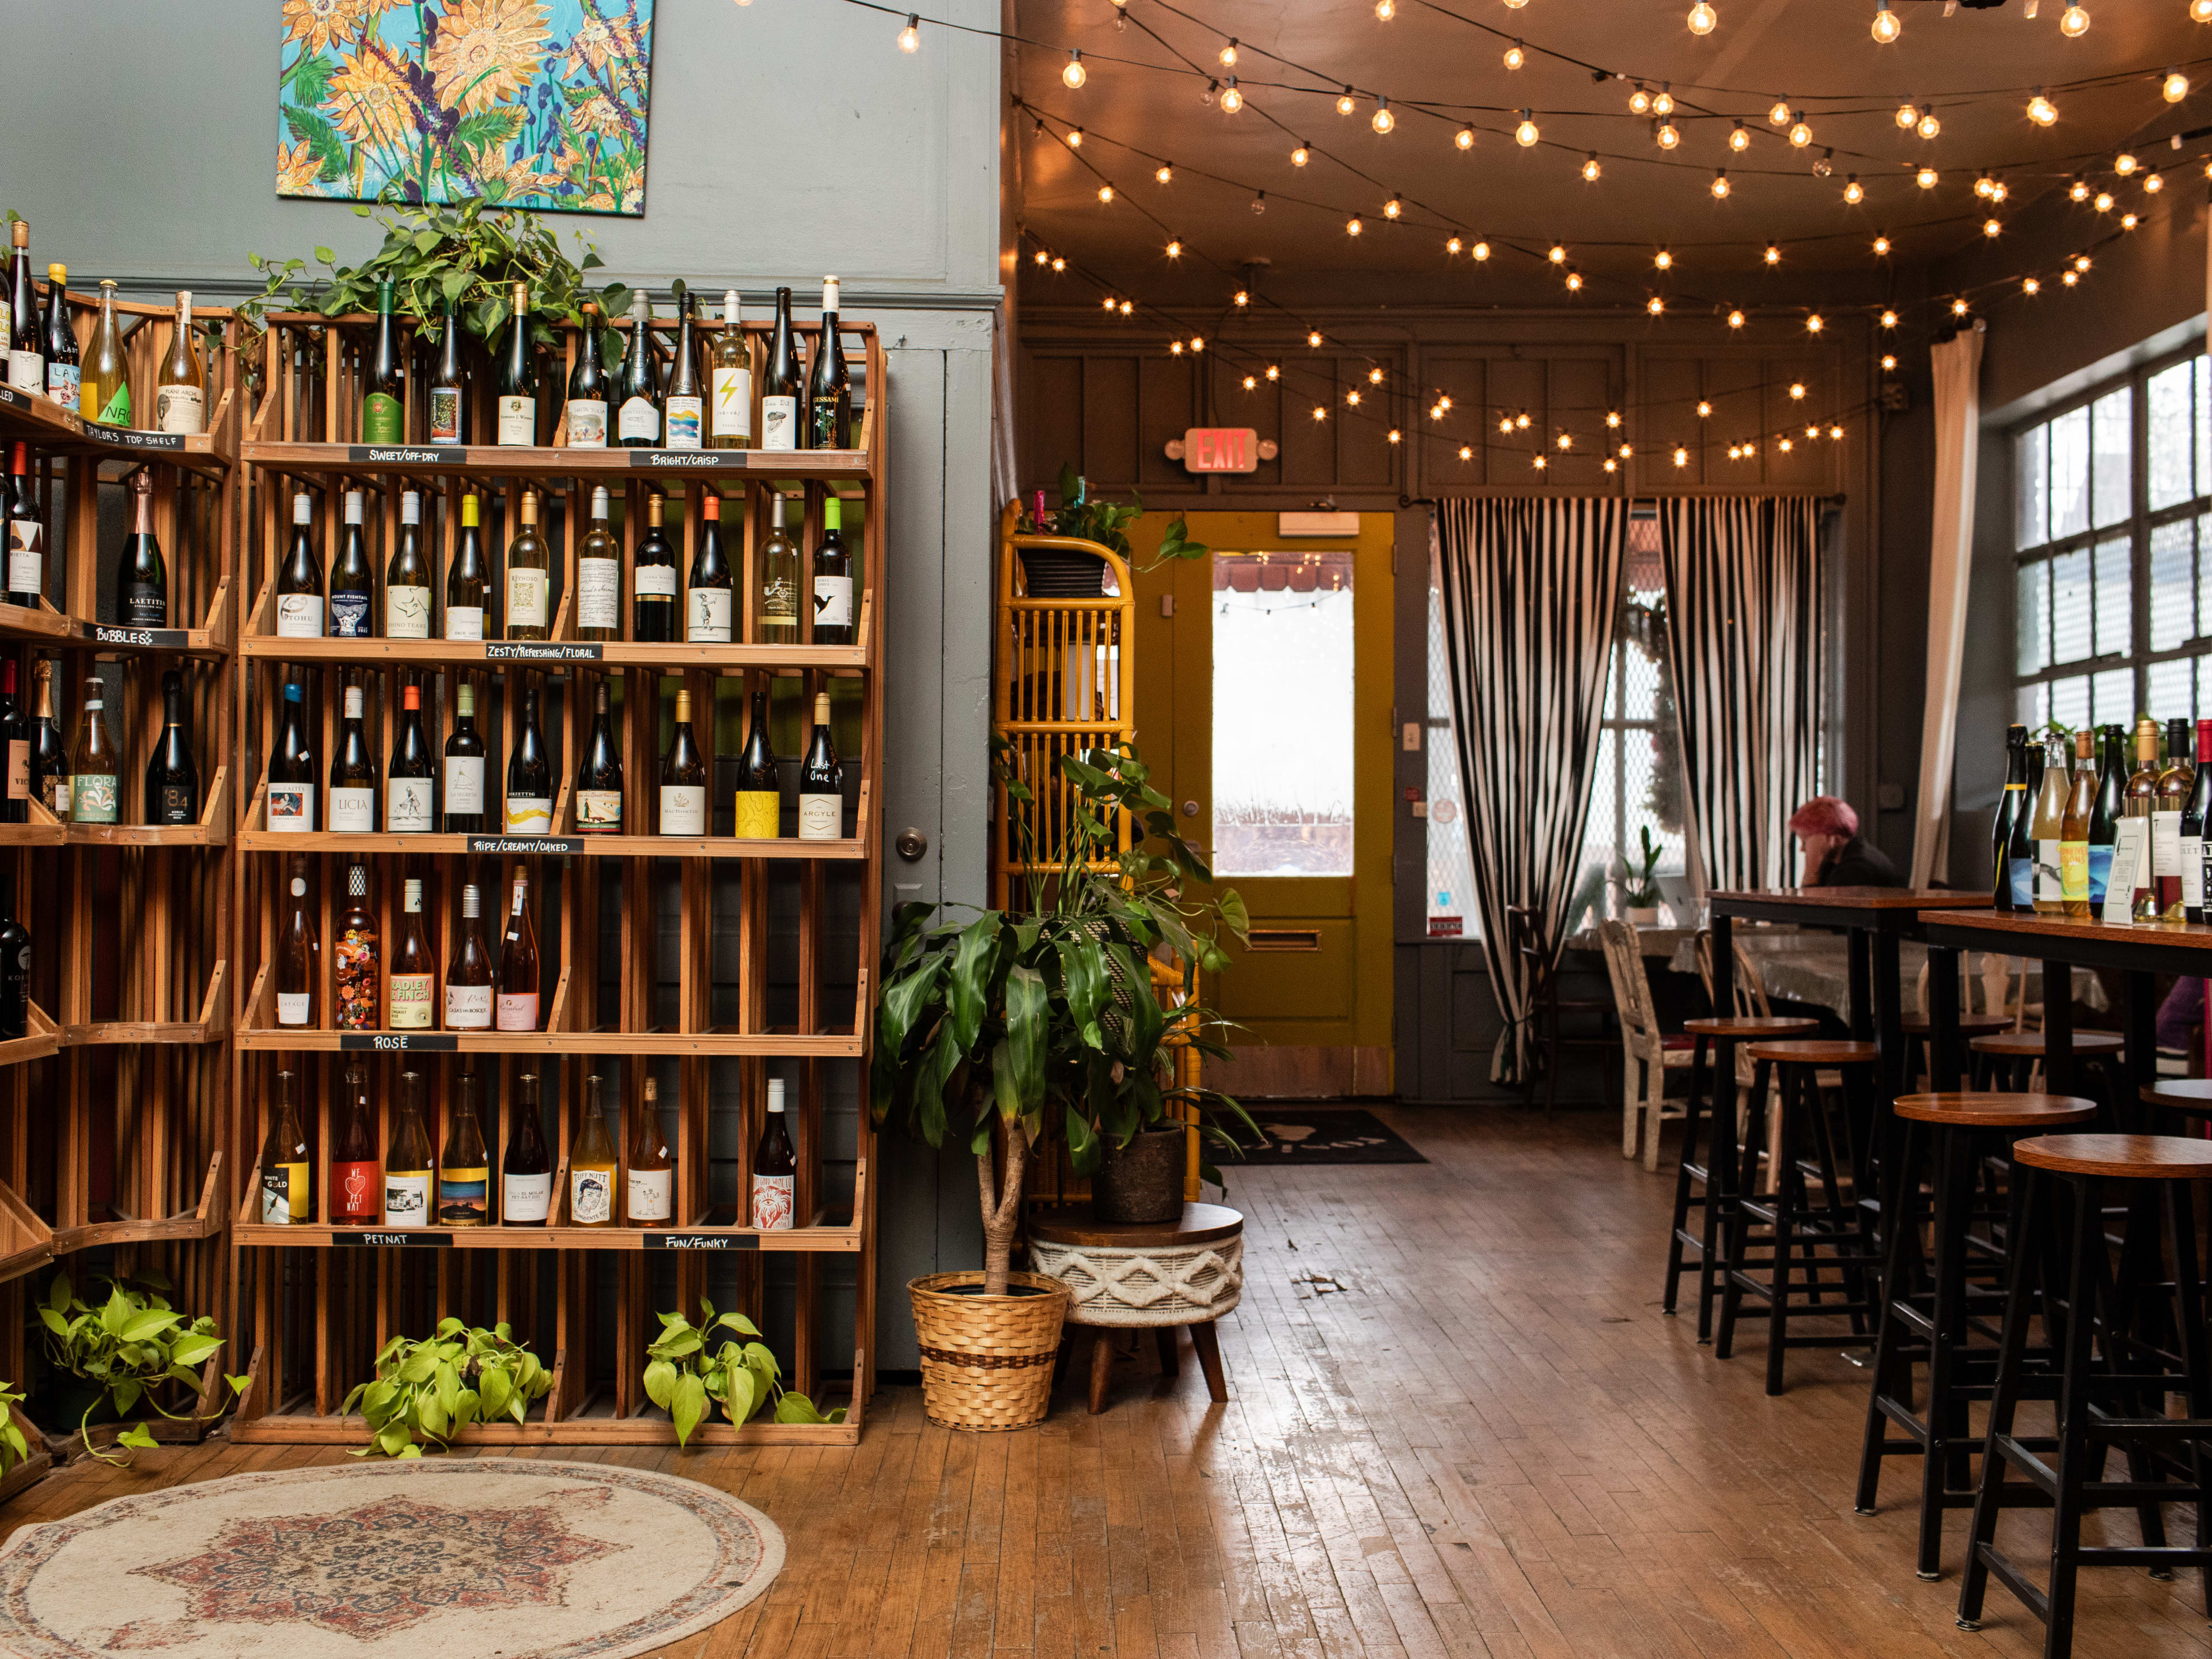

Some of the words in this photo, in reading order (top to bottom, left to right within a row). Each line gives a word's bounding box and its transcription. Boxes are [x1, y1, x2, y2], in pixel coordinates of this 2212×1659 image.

[62, 346, 78, 354] LAST
[54, 368, 69, 377] LA
[86, 425, 119, 442] TAYLOR'S
[124, 435, 143, 445] TOP
[145, 437, 177, 445] SHELF
[1196, 430, 1248, 469] EXIT
[369, 449, 440, 462] SWEET/OFF-DRY
[130, 598, 165, 606] LAETITIA
[810, 757, 830, 770] Last
[77, 776, 116, 787] FLORA
[810, 770, 830, 782] One
[339, 799, 368, 810] LICIA
[392, 980, 428, 991] RADLEY
[397, 990, 429, 1001] FINCH
[351, 1168, 360, 1178] WE
[589, 1172, 607, 1183] NUTT
[350, 1194, 363, 1203] PET
[347, 1202, 360, 1211] NAT
[665, 1236, 728, 1249] FUN/FUNKY
